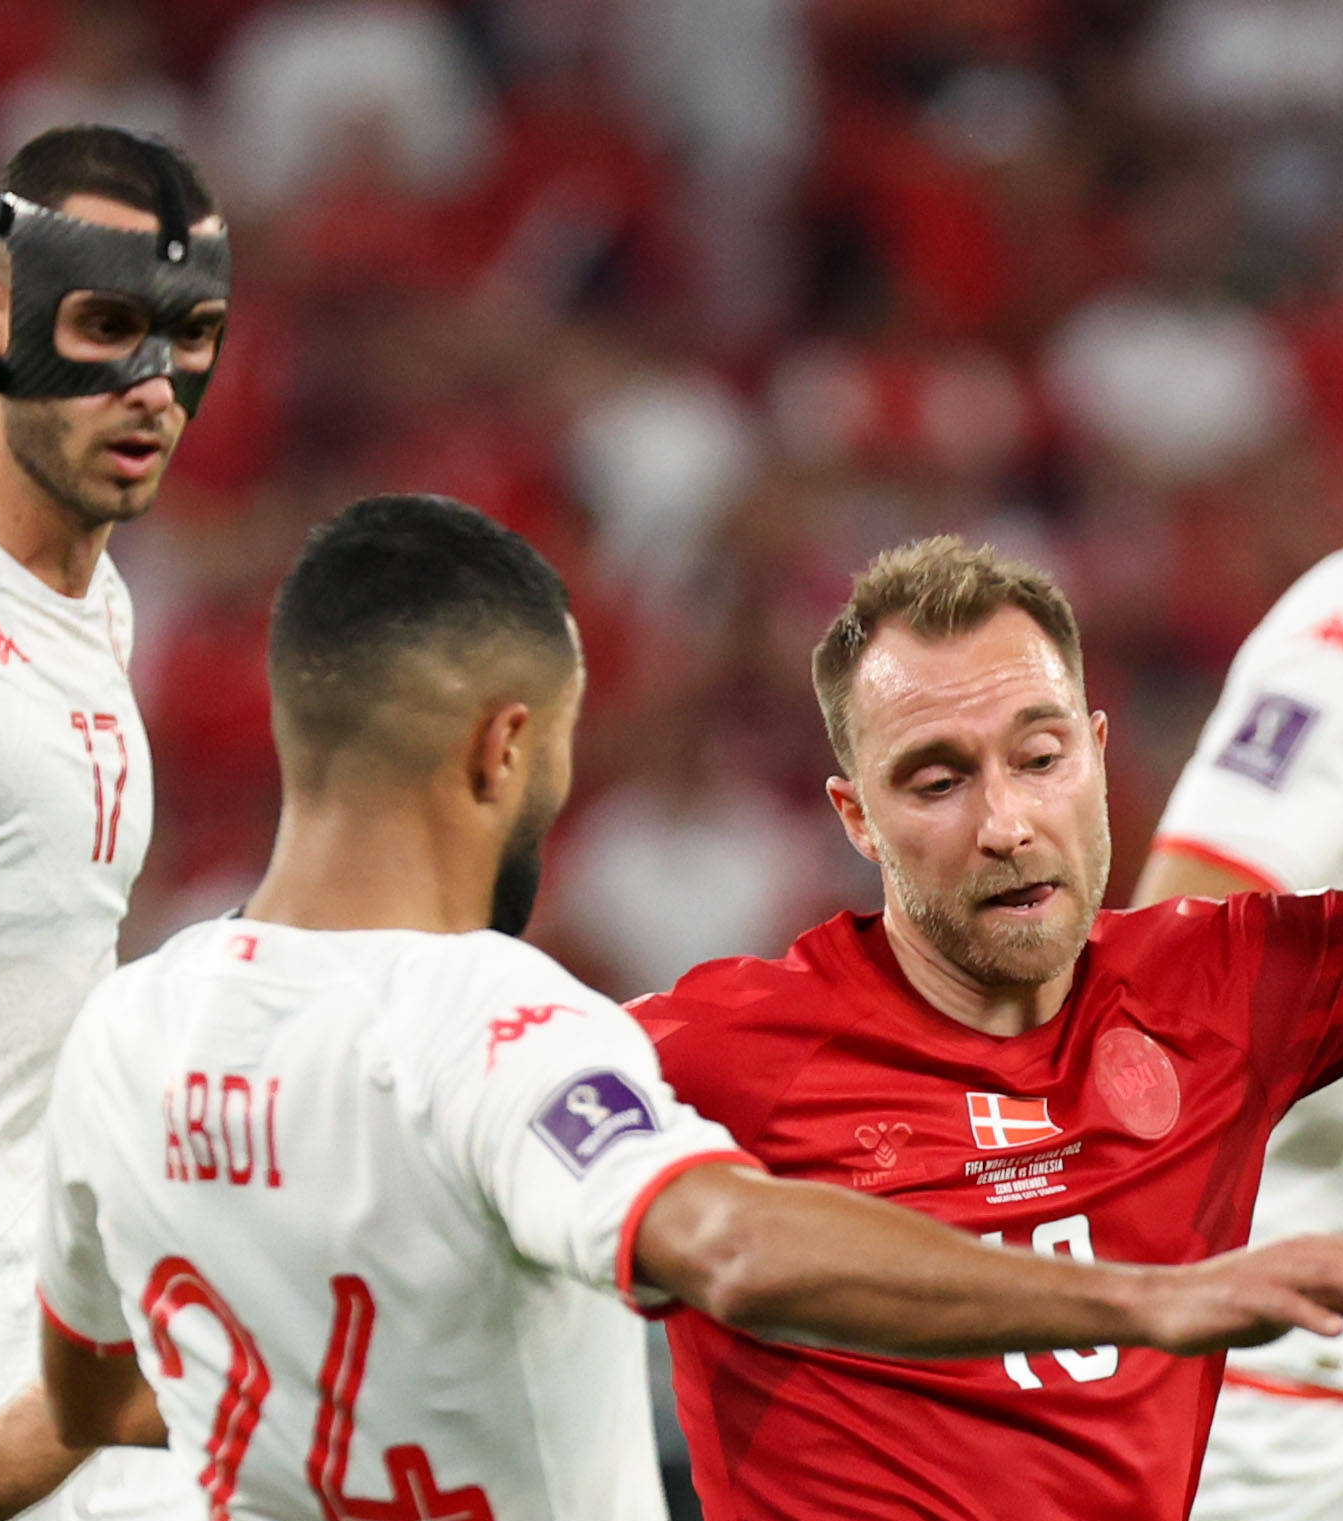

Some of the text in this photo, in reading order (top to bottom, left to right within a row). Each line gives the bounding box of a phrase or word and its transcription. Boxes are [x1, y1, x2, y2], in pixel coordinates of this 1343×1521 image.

[70, 711, 127, 864] 17
[163, 1071, 283, 1188] ABDI
[965, 1160, 984, 1176] FIFA
[976, 1166, 1017, 1185] DENMARK
